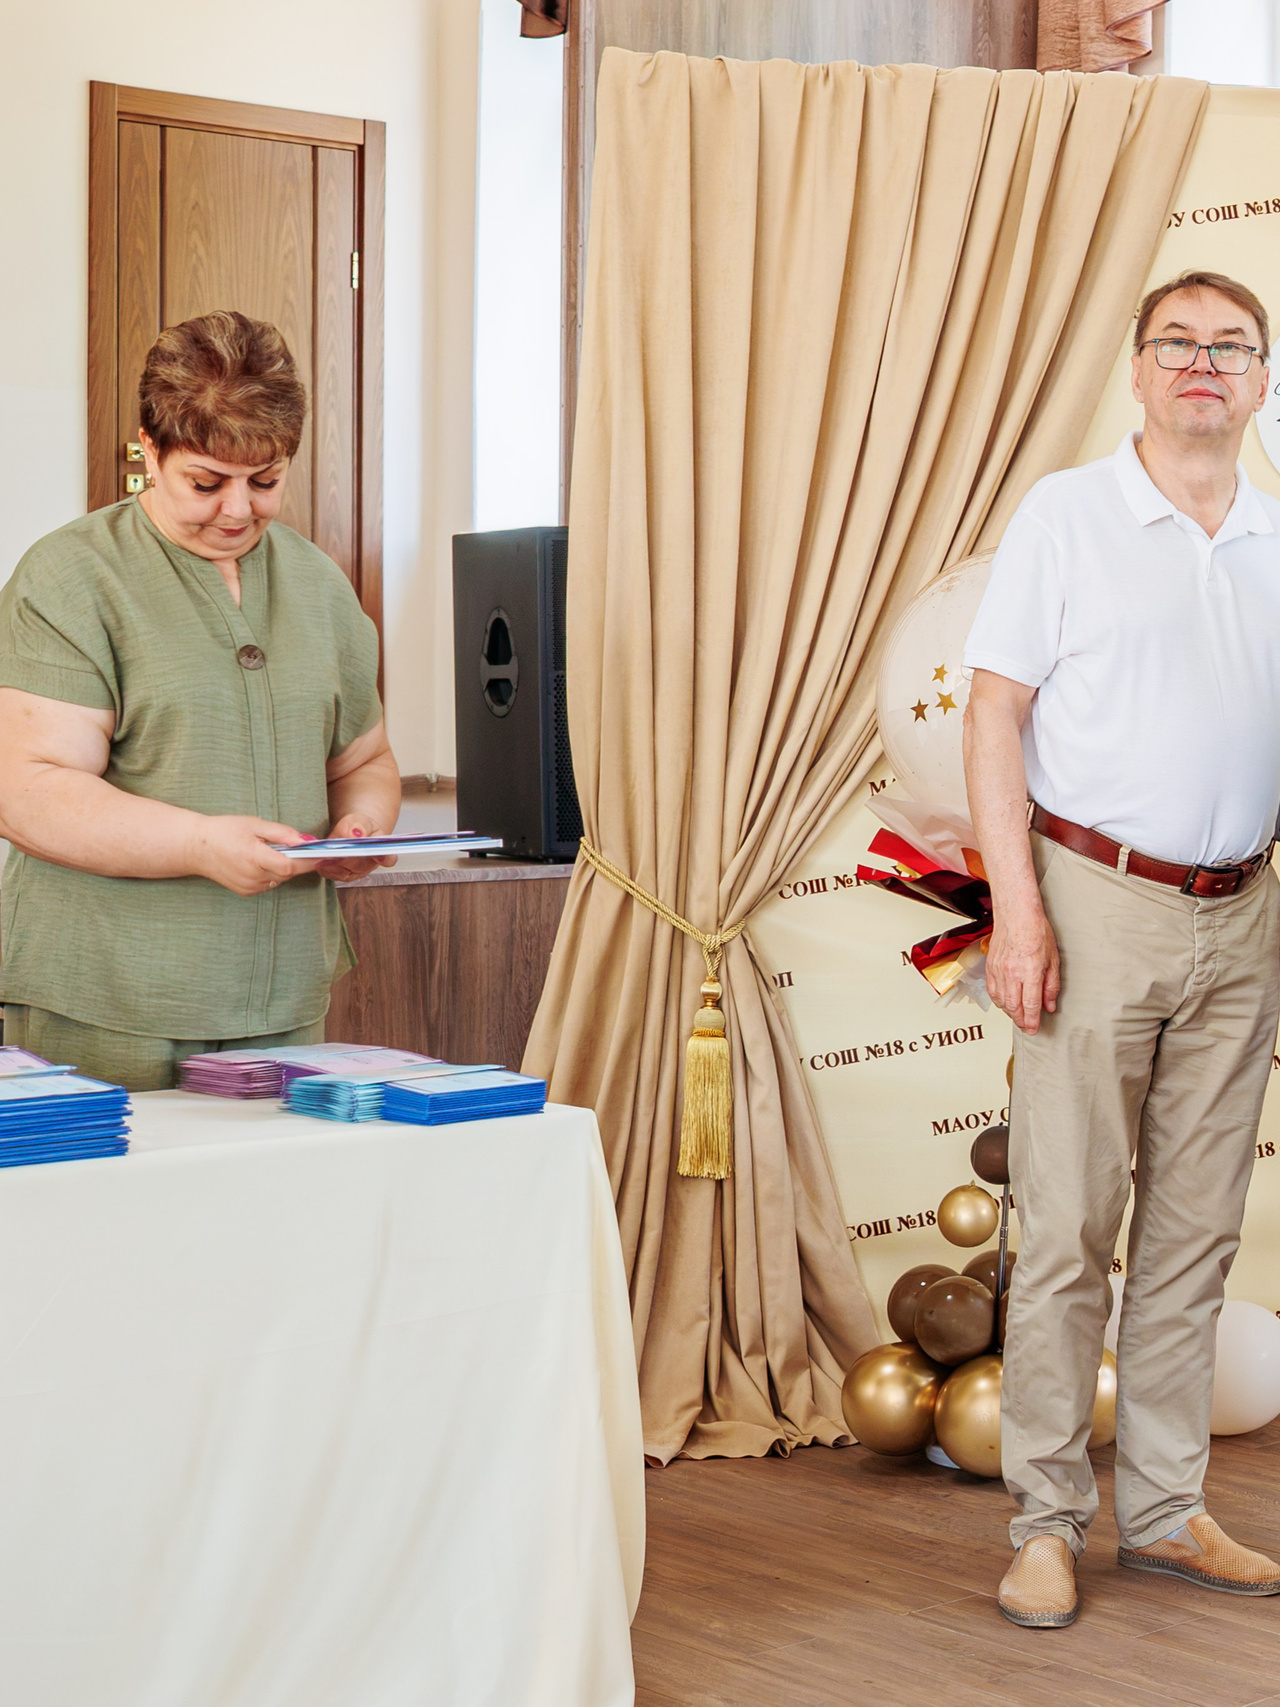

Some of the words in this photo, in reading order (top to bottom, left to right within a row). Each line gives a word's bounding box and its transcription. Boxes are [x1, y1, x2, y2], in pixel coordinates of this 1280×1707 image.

[1192, 205, 1239, 224] СОШ
[810, 1048, 860, 1070] СОШ
[865, 1040, 904, 1060] №18
[909, 1042, 918, 1052] с
[922, 1025, 983, 1049] УИОП
[931, 1109, 994, 1136] МАОУ
[897, 1210, 936, 1232] №18
